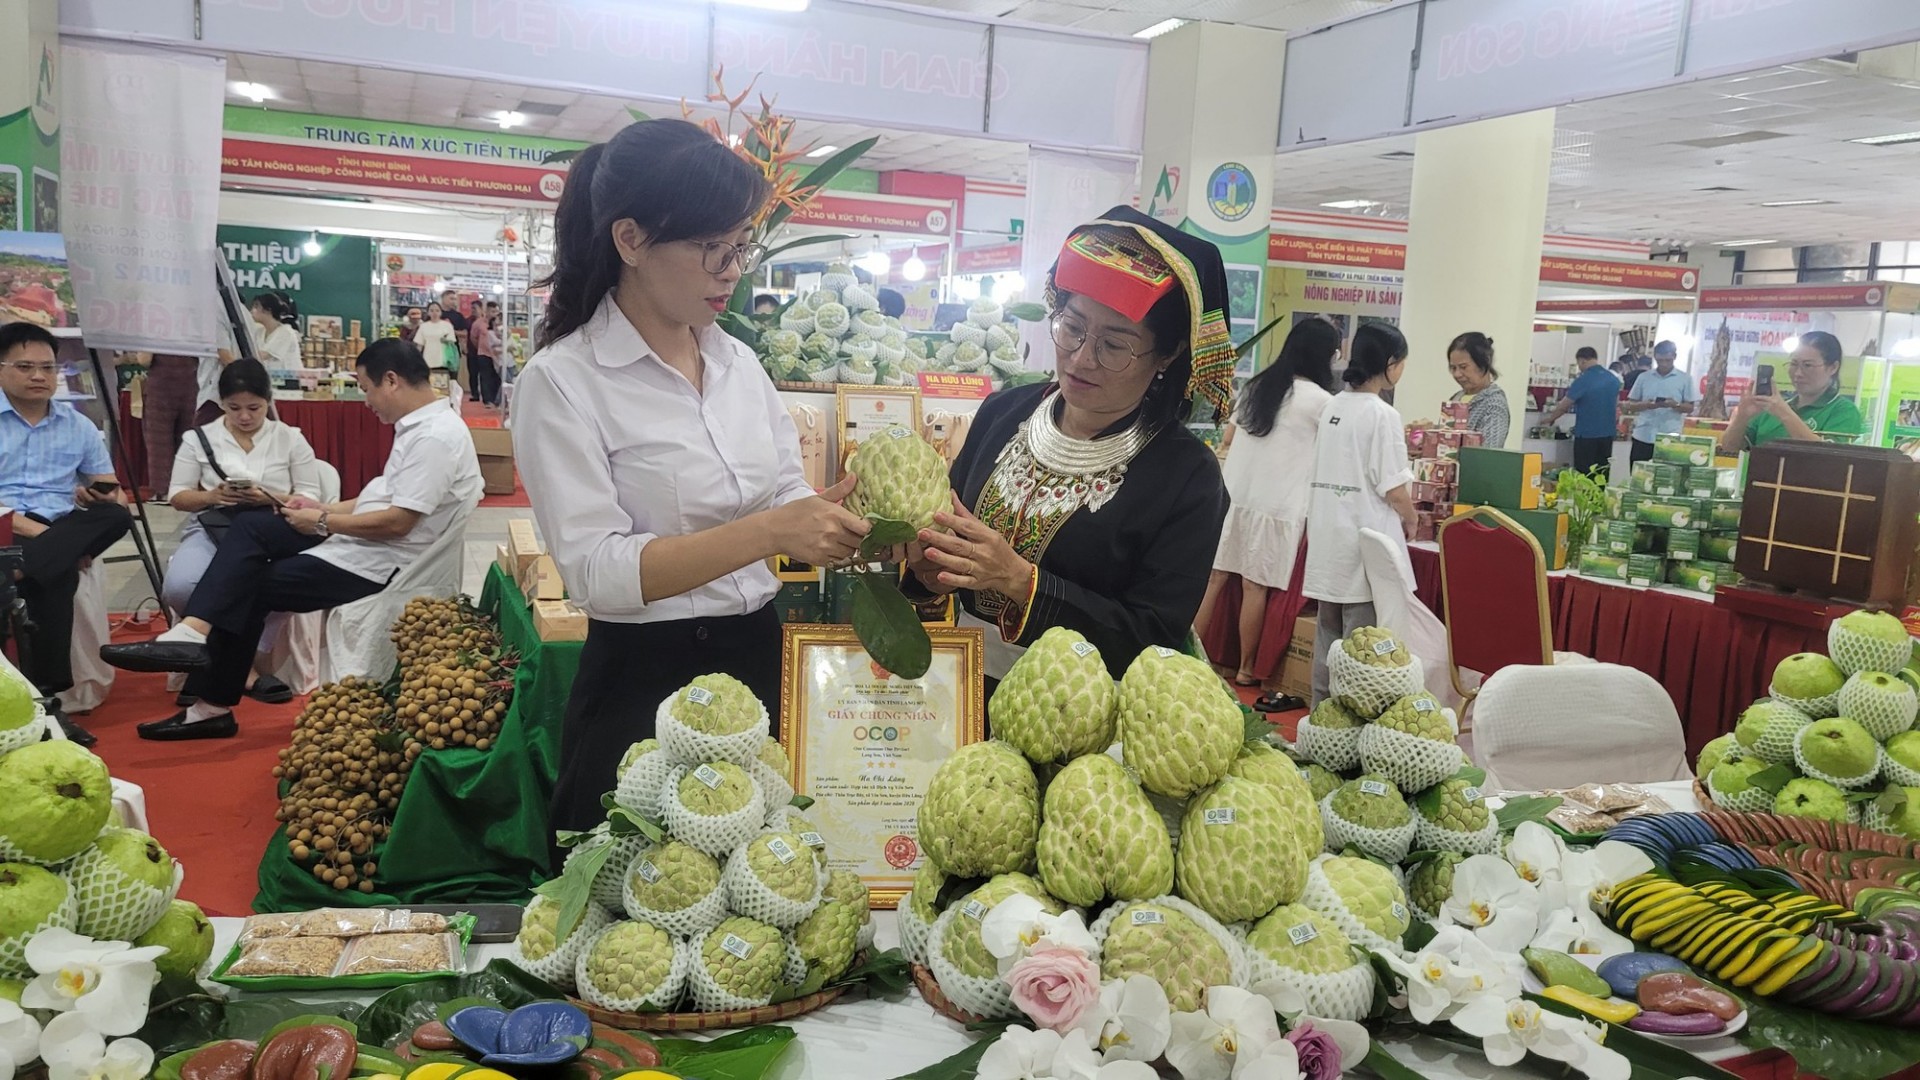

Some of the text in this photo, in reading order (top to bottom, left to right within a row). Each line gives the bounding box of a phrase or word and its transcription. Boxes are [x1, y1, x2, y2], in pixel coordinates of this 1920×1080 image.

[304, 126, 370, 145] TRUNG
[376, 131, 415, 150] TÂM
[421, 136, 458, 154] XÚC
[463, 139, 503, 159] TIẾN
[336, 156, 411, 172] TỈNH NINH BÌNH
[241, 158, 262, 168] TÂM
[264, 160, 295, 171] NÔNG
[296, 164, 333, 176] NGHIỆP
[335, 167, 363, 178] CÔNG
[364, 171, 392, 181] NGHỆ
[393, 174, 414, 182] CAO
[416, 174, 429, 184] VÀ
[430, 175, 450, 186] XÚC
[452, 176, 474, 188] TIẾN
[514, 184, 532, 195] MẠI
[544, 180, 561, 193] A58
[808, 211, 825, 220] CAO
[827, 211, 837, 220] VÀ
[930, 216, 944, 227] A57
[223, 241, 301, 265] THIỆU
[1304, 283, 1329, 301] NÔNG
[1331, 286, 1363, 306] NGHIỆP
[1365, 287, 1377, 304] VÀ
[925, 374, 940, 384] NA
[827, 708, 856, 720] GIẤY
[903, 710, 937, 722] NHẬN
[853, 726, 911, 741] OCOP
